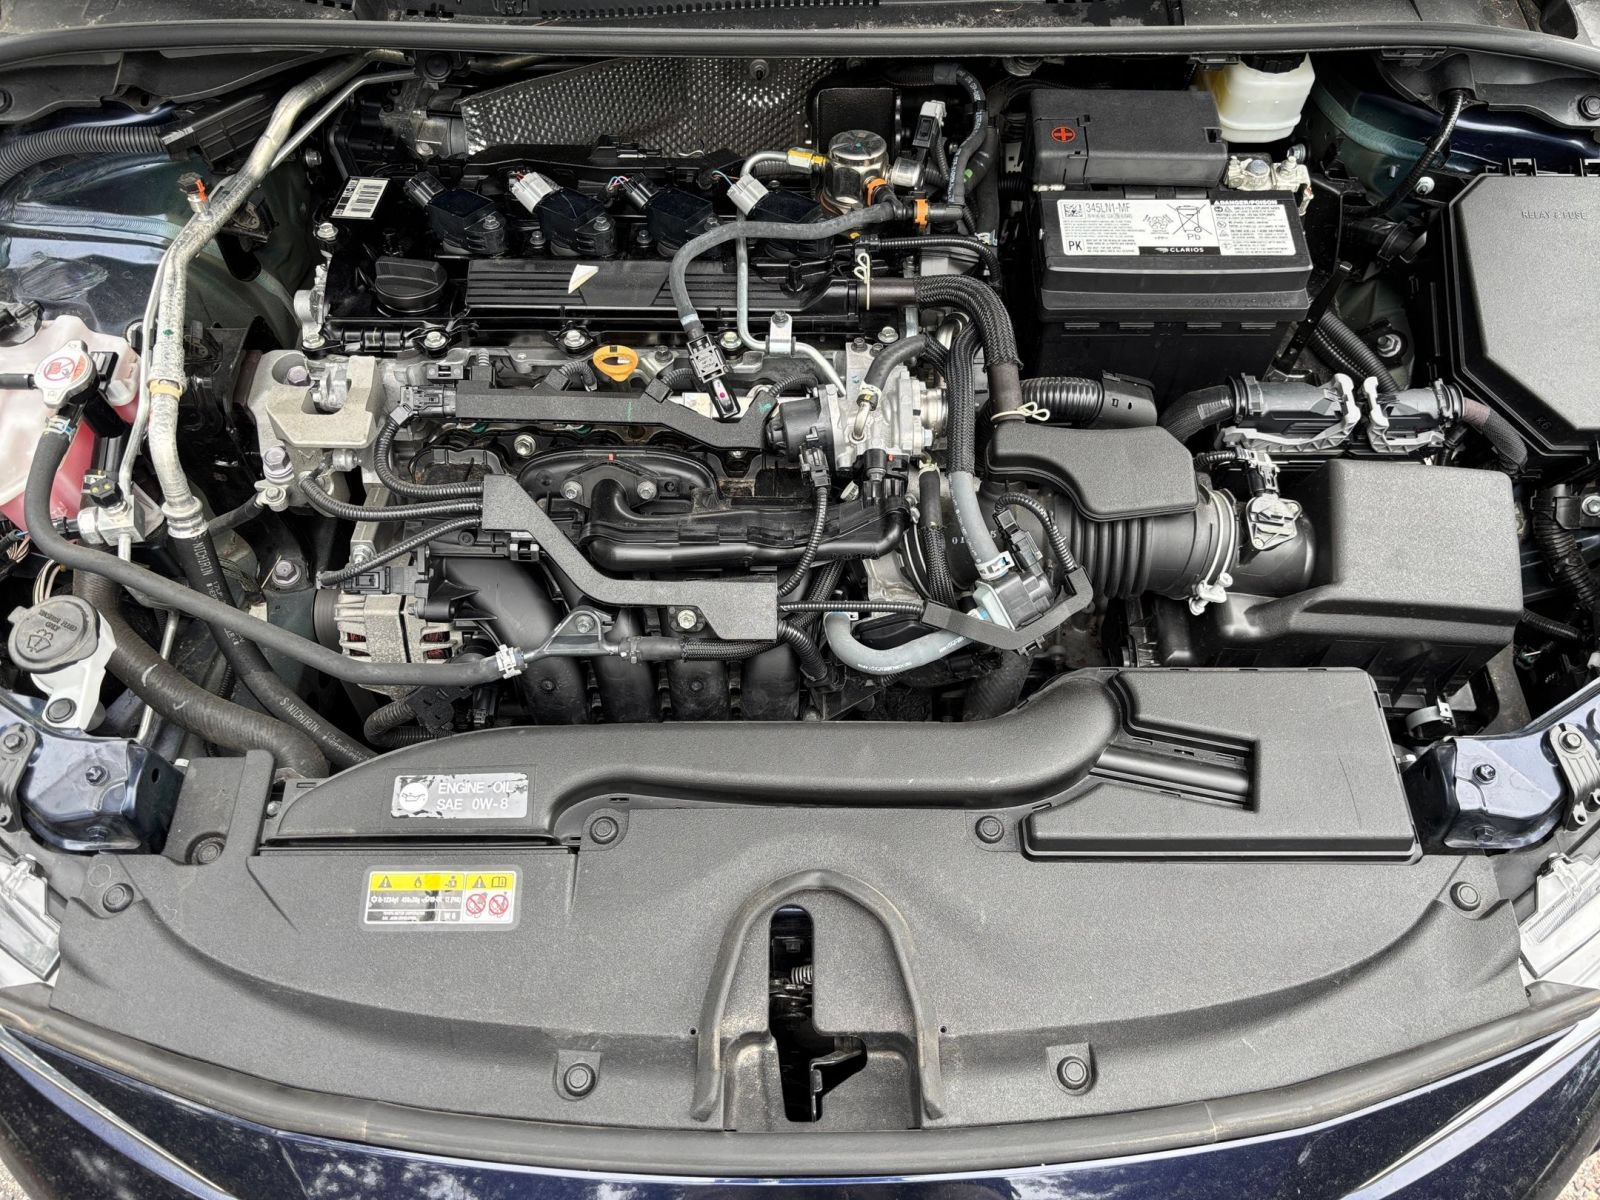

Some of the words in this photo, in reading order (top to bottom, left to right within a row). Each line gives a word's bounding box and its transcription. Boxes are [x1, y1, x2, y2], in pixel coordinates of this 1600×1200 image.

[1085, 202, 1131, 213] 345LN1-MF
[1521, 210, 1550, 219] RELAY
[1563, 211, 1586, 220] FUSE
[1186, 233, 1202, 241] Pb
[1068, 240, 1083, 252] PK
[438, 782, 485, 794] ENGINE
[492, 781, 513, 793] OIL
[437, 799, 463, 810] SAE
[471, 798, 508, 810] 0W-8
